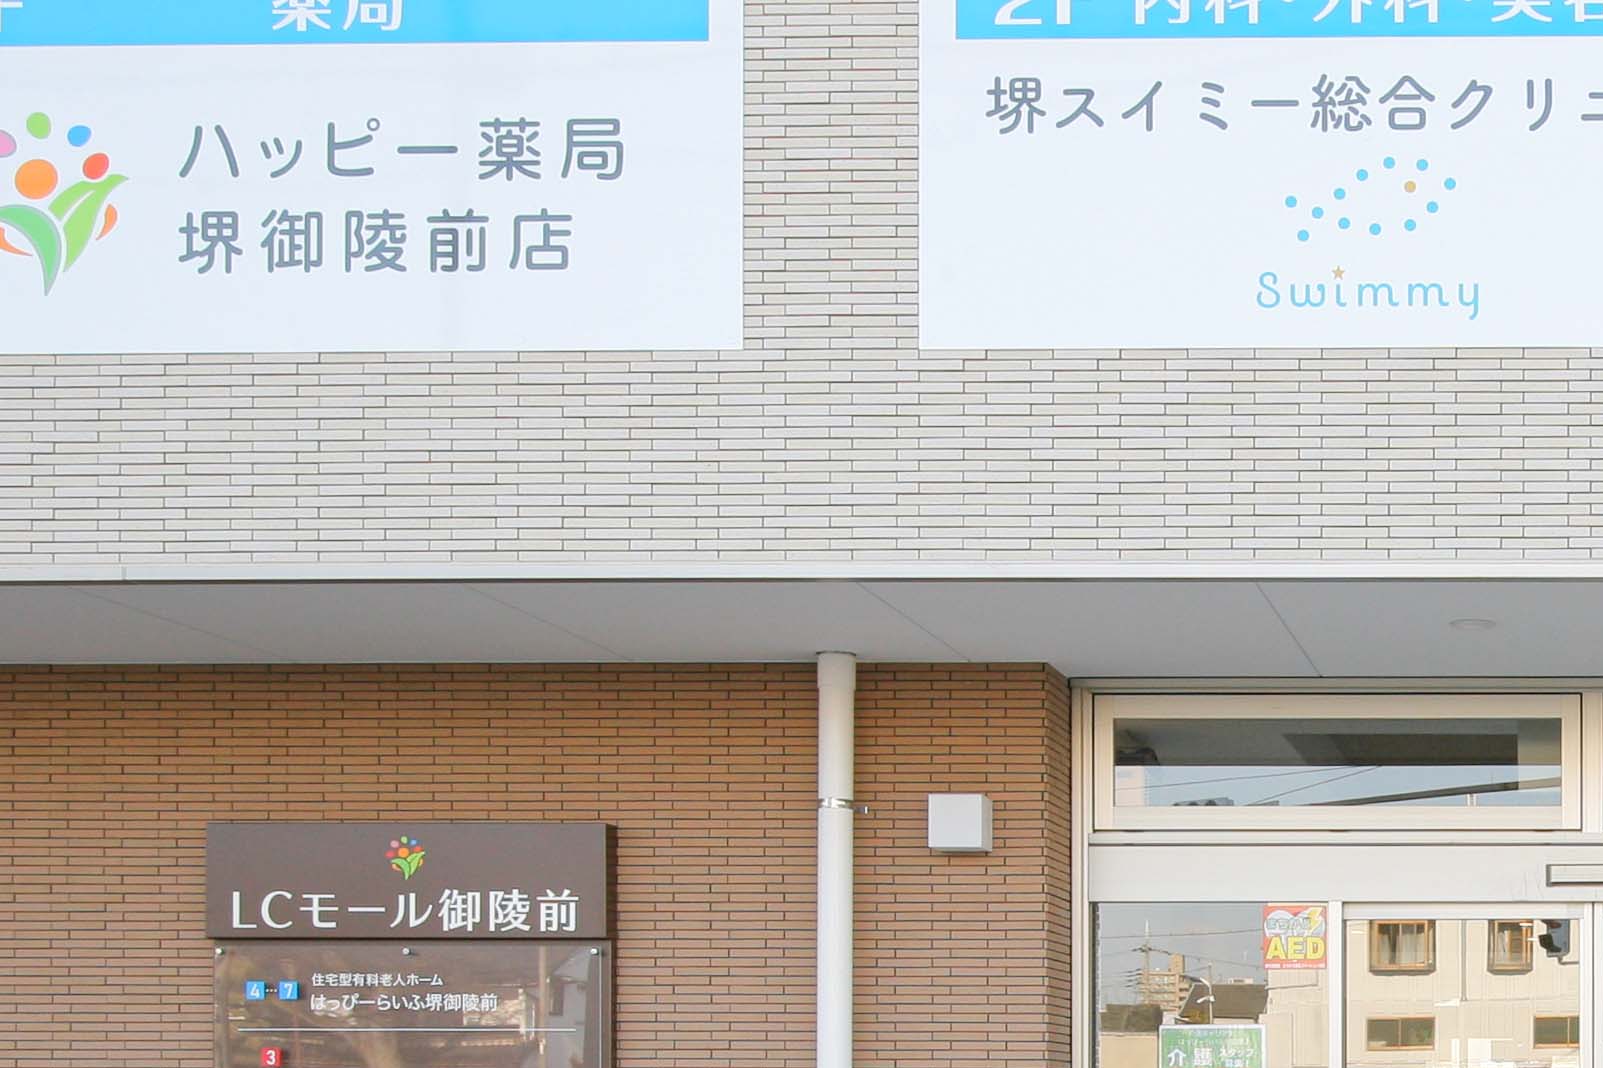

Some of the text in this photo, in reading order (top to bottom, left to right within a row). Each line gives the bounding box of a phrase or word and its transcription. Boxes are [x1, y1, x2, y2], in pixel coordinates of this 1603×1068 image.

[178, 117, 626, 182] ハッピー薬局
[178, 207, 575, 275] 堺御陵前店
[1255, 267, 1480, 321] Swimmy
[231, 888, 580, 933] LCモール御陵前
[1265, 935, 1326, 960] AED
[311, 973, 444, 987] 住宅型有料老人ホーム
[311, 993, 498, 1012] はっぴーらいふ堺御陵前
